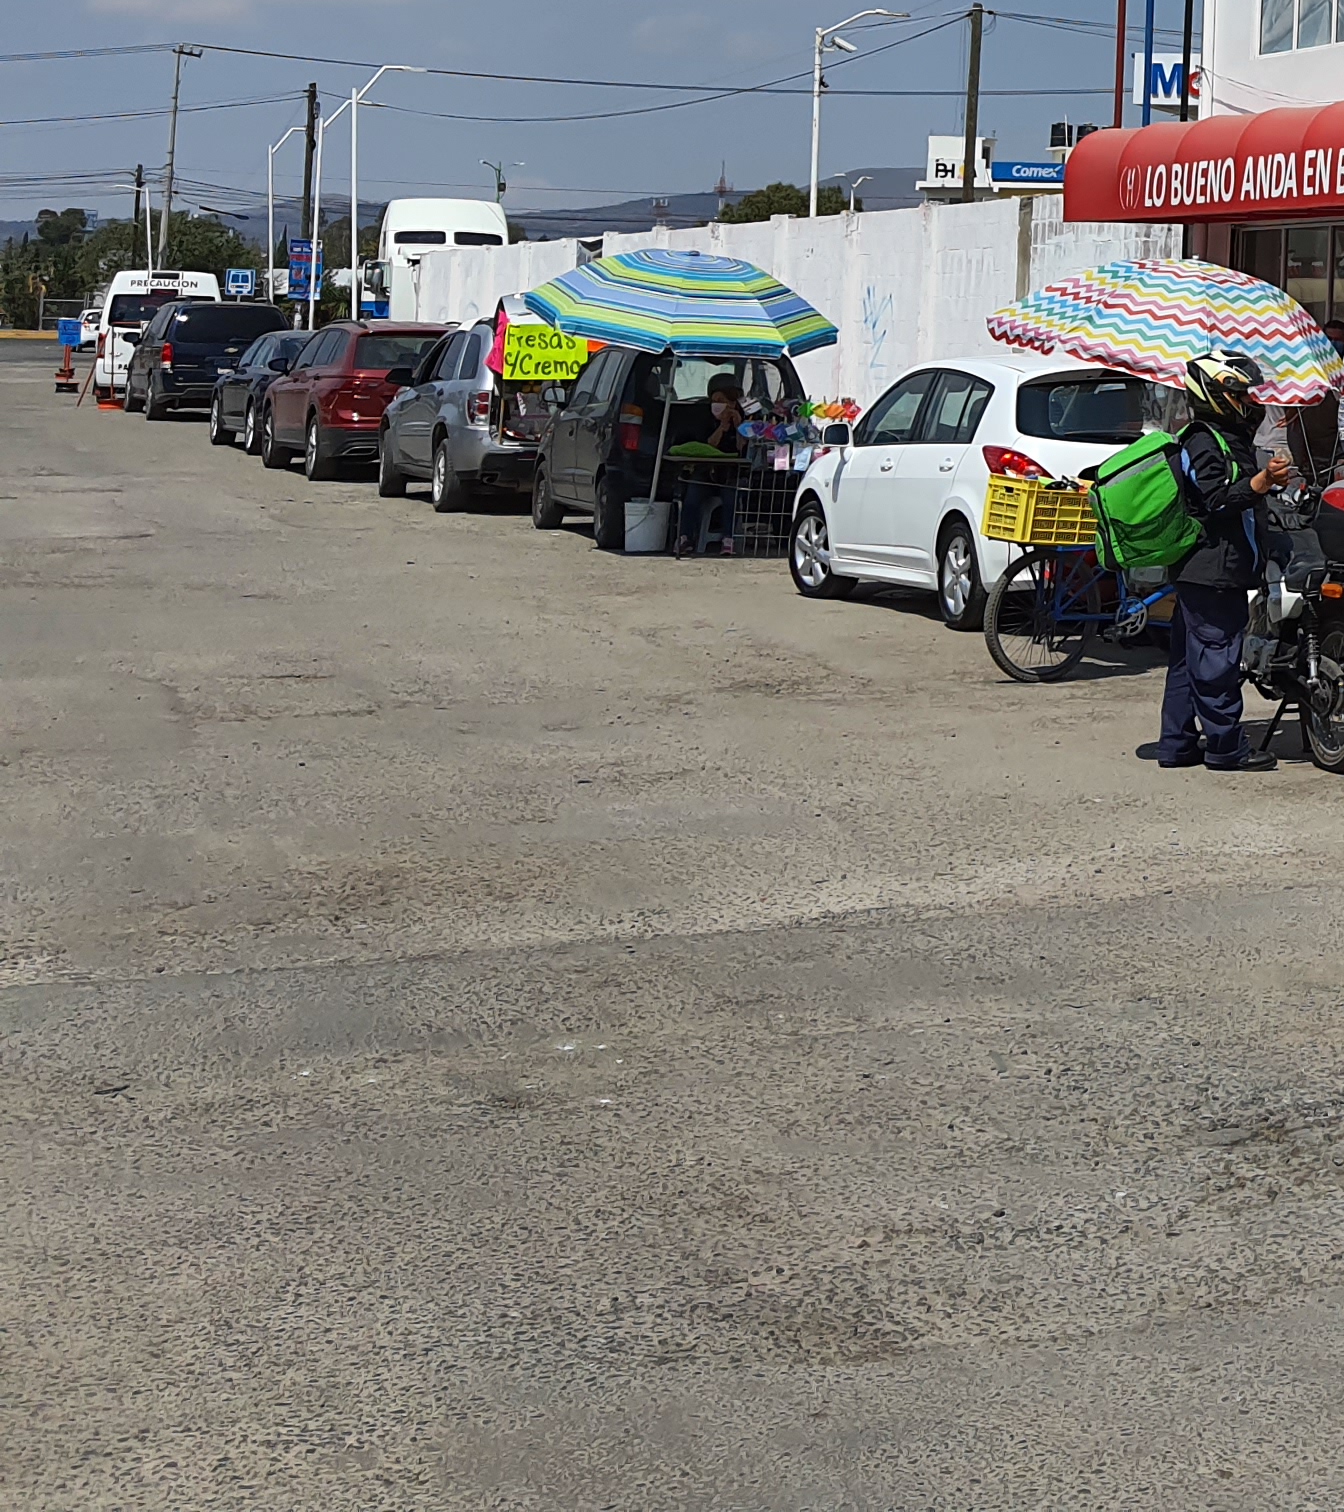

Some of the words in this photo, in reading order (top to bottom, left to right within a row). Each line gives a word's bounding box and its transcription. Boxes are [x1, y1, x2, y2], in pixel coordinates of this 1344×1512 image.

[1012, 165, 1063, 178] Comex
[1143, 162, 1168, 208] LO
[1170, 159, 1235, 206] BUENO
[1240, 152, 1298, 201] ANDA
[1303, 147, 1334, 196] EN
[507, 324, 577, 350] Fresas
